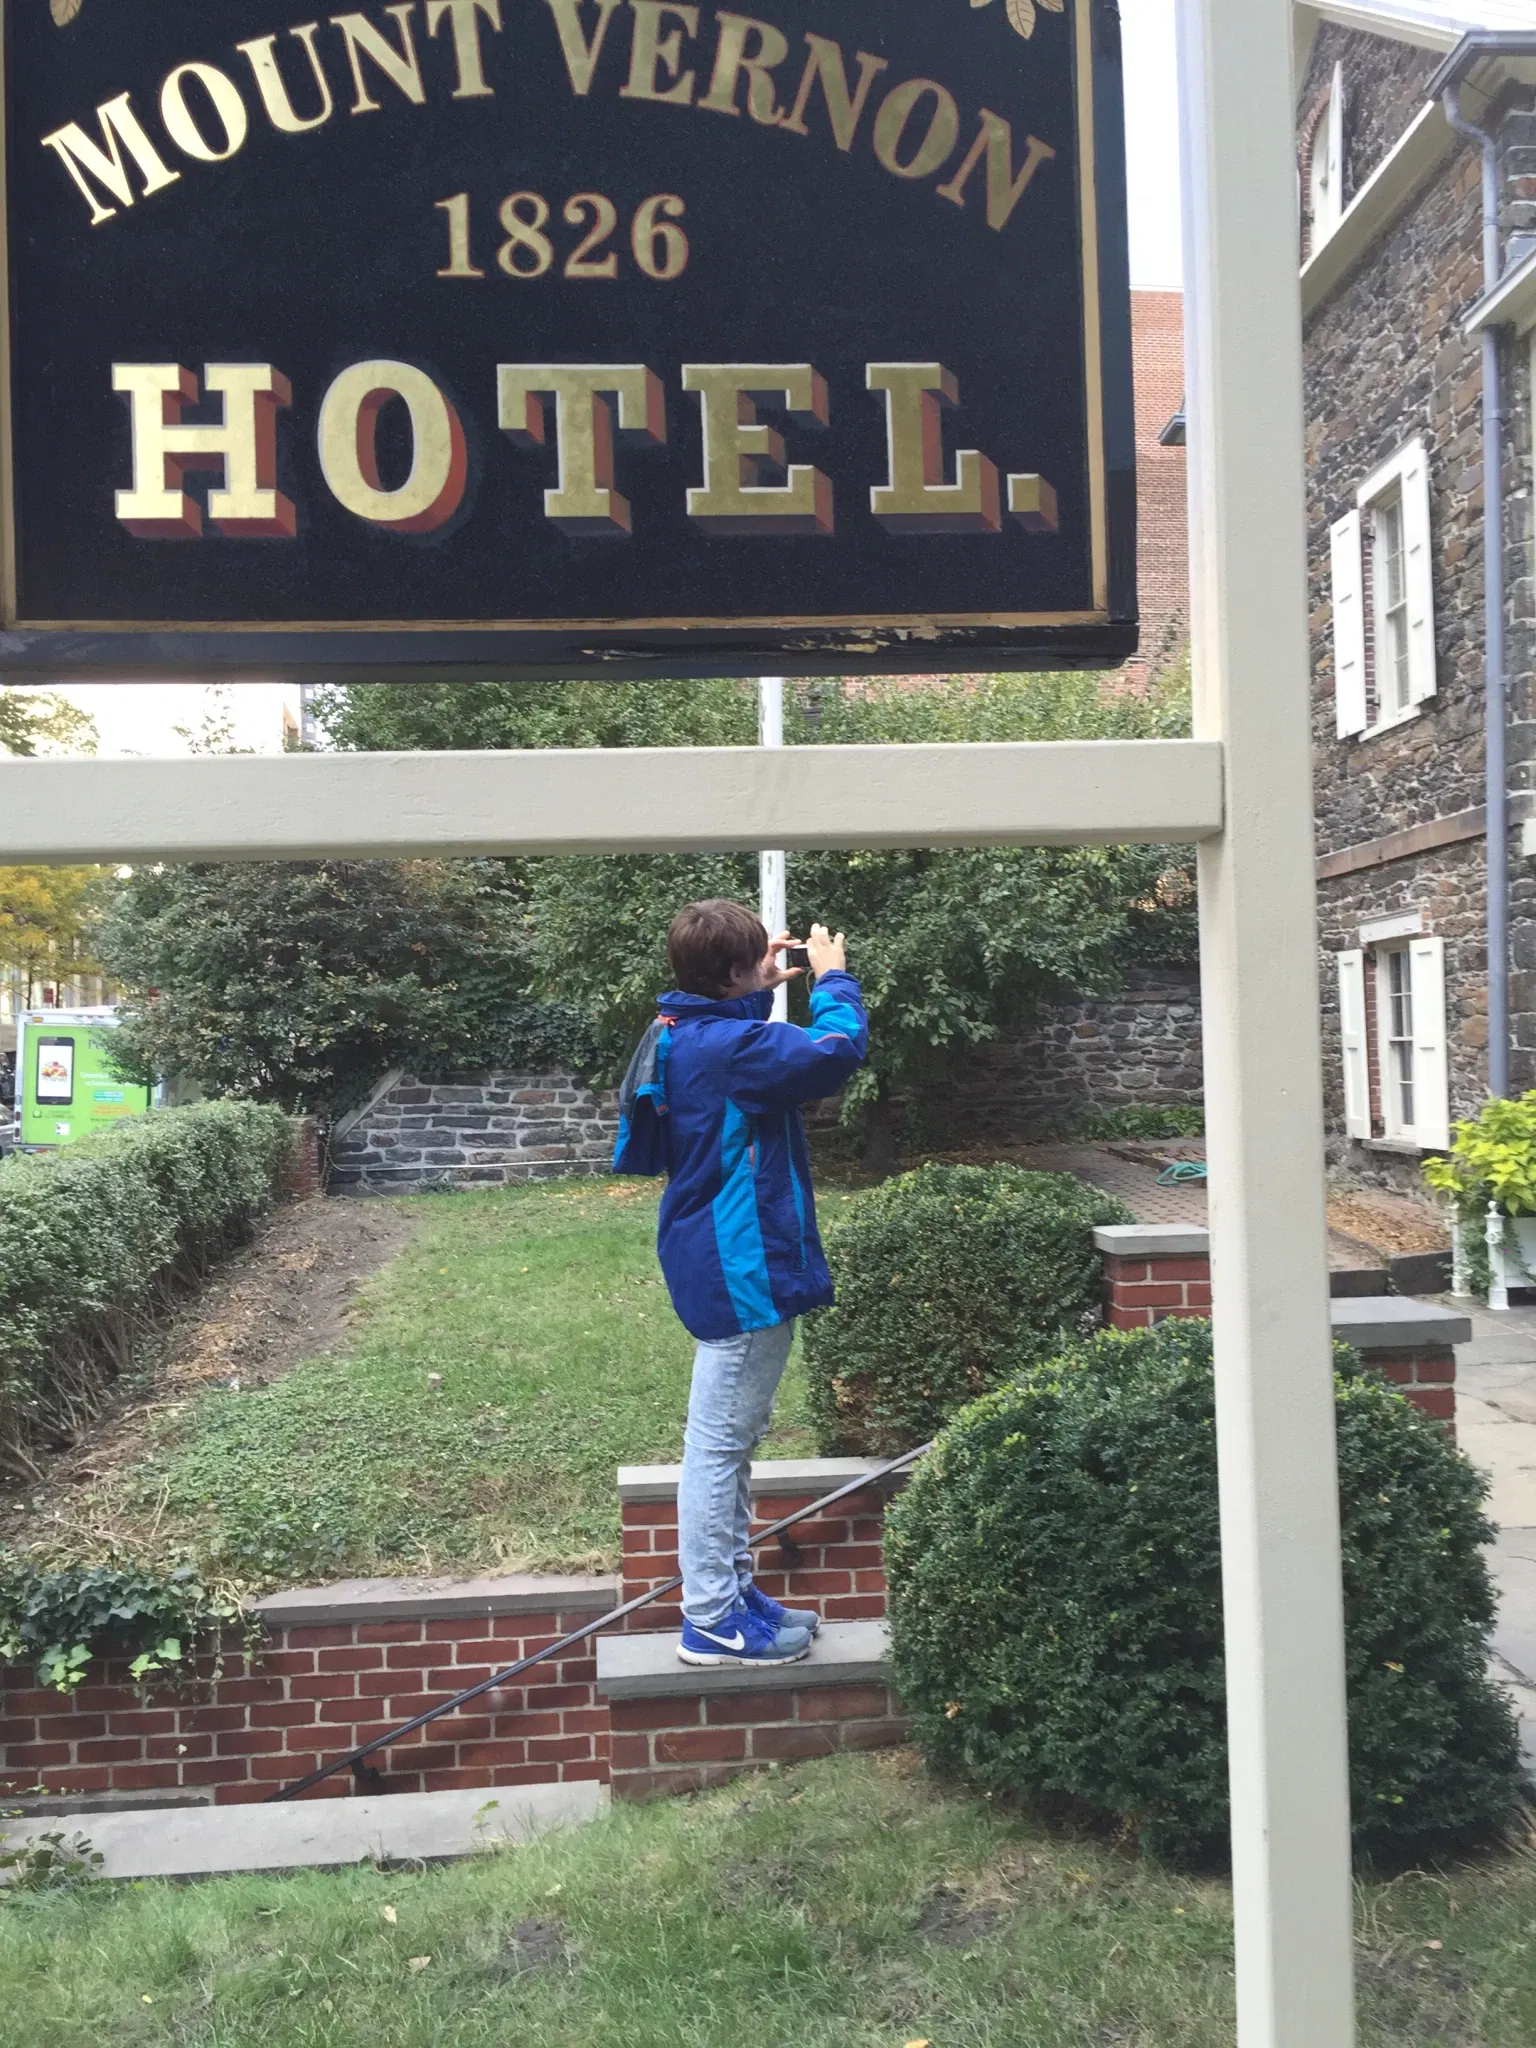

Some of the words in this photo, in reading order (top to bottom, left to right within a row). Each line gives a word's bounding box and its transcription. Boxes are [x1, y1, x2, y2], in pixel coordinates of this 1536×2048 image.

[41, 0, 502, 225] MOUNT
[544, 0, 1056, 231] VERNON
[434, 191, 689, 281] 1826
